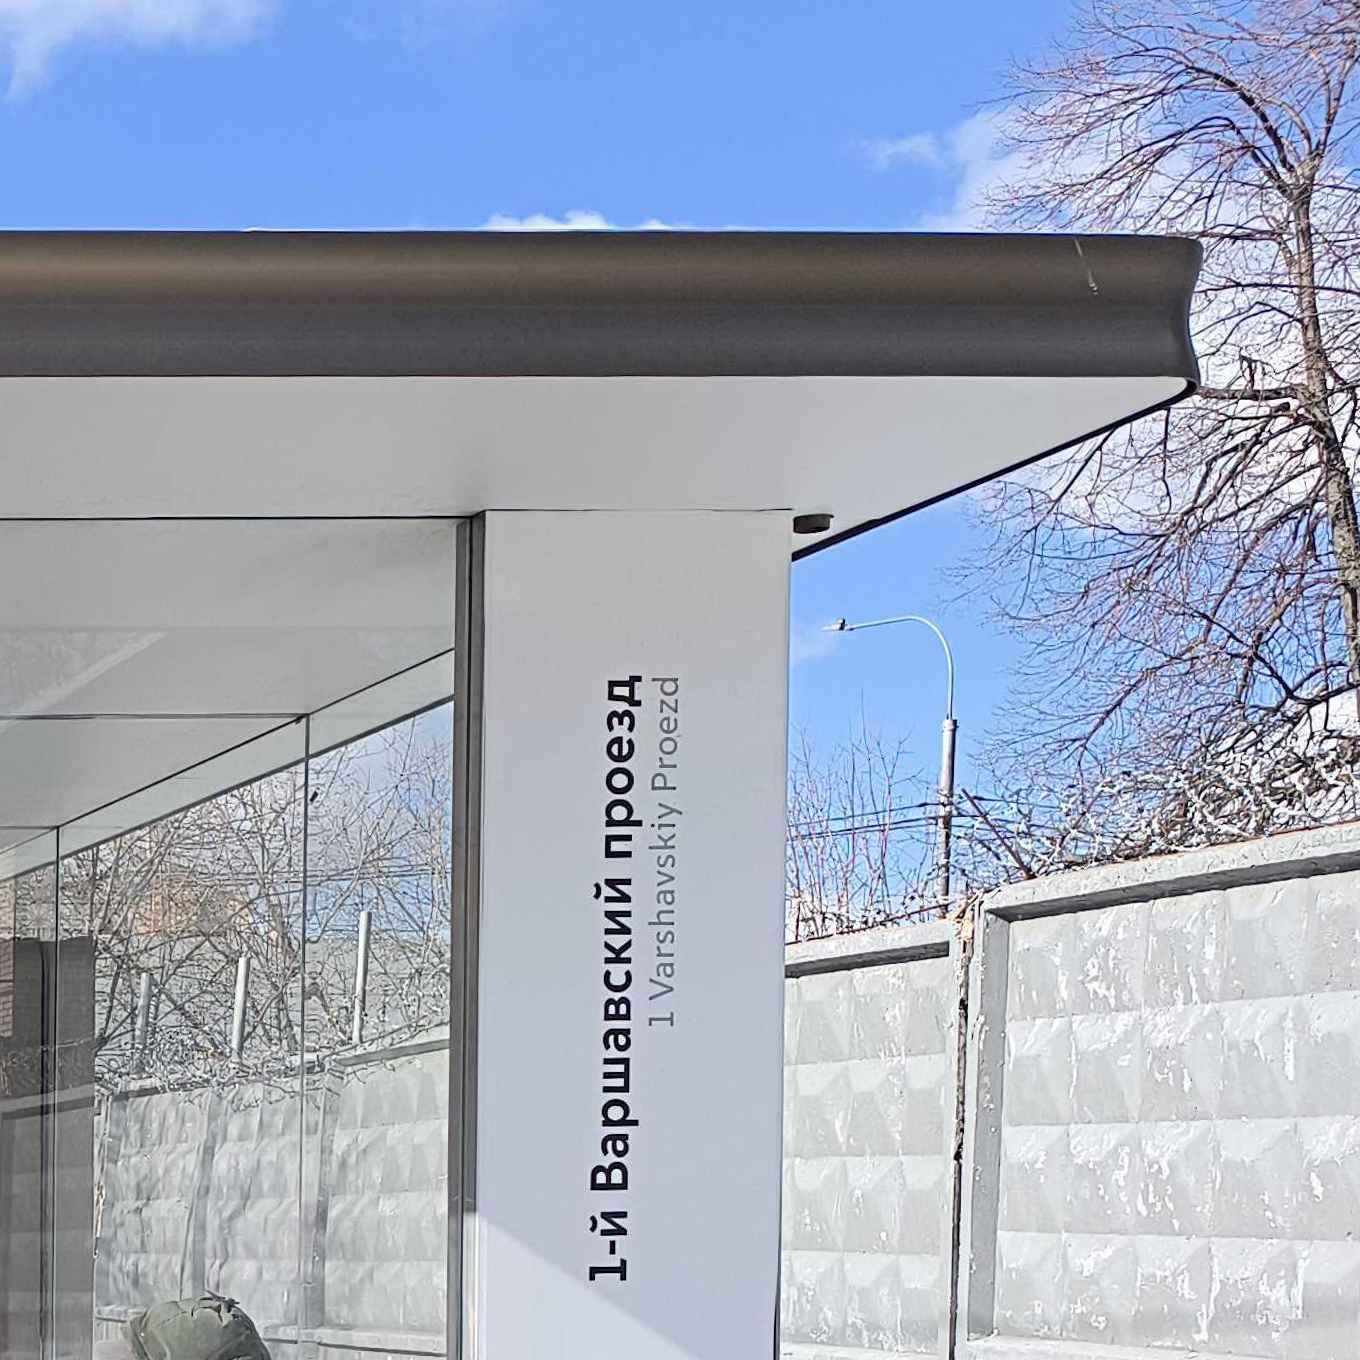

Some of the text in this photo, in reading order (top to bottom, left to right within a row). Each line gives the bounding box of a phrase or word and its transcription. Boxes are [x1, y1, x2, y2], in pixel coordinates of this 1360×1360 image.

[589, 675, 642, 1281] 1-й Варшавский проезд
[647, 677, 682, 1027] 1 Varshavskiy Proezd
